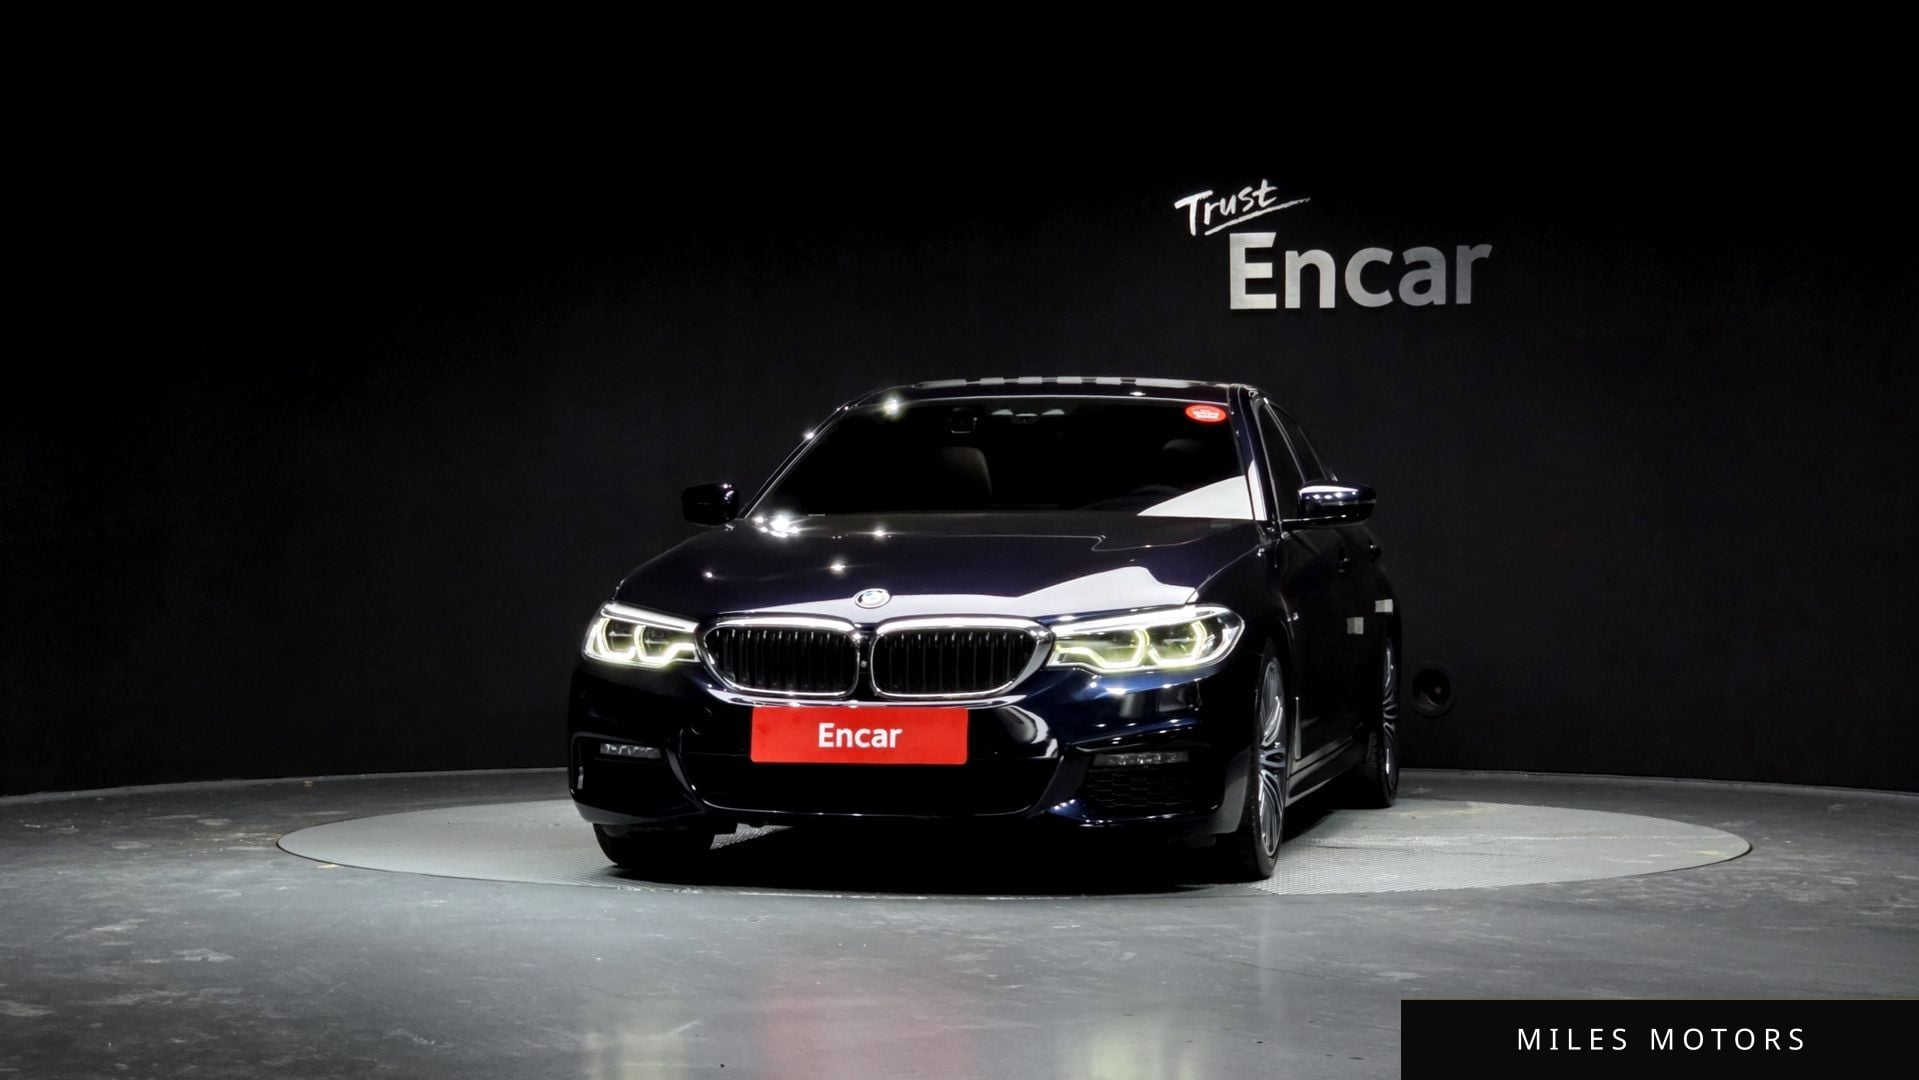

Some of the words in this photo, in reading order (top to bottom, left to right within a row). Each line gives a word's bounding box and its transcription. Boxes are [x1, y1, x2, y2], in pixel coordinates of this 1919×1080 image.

[1174, 178, 1278, 236] Trust
[1229, 231, 1494, 310] Encar
[818, 722, 903, 749] Encar
